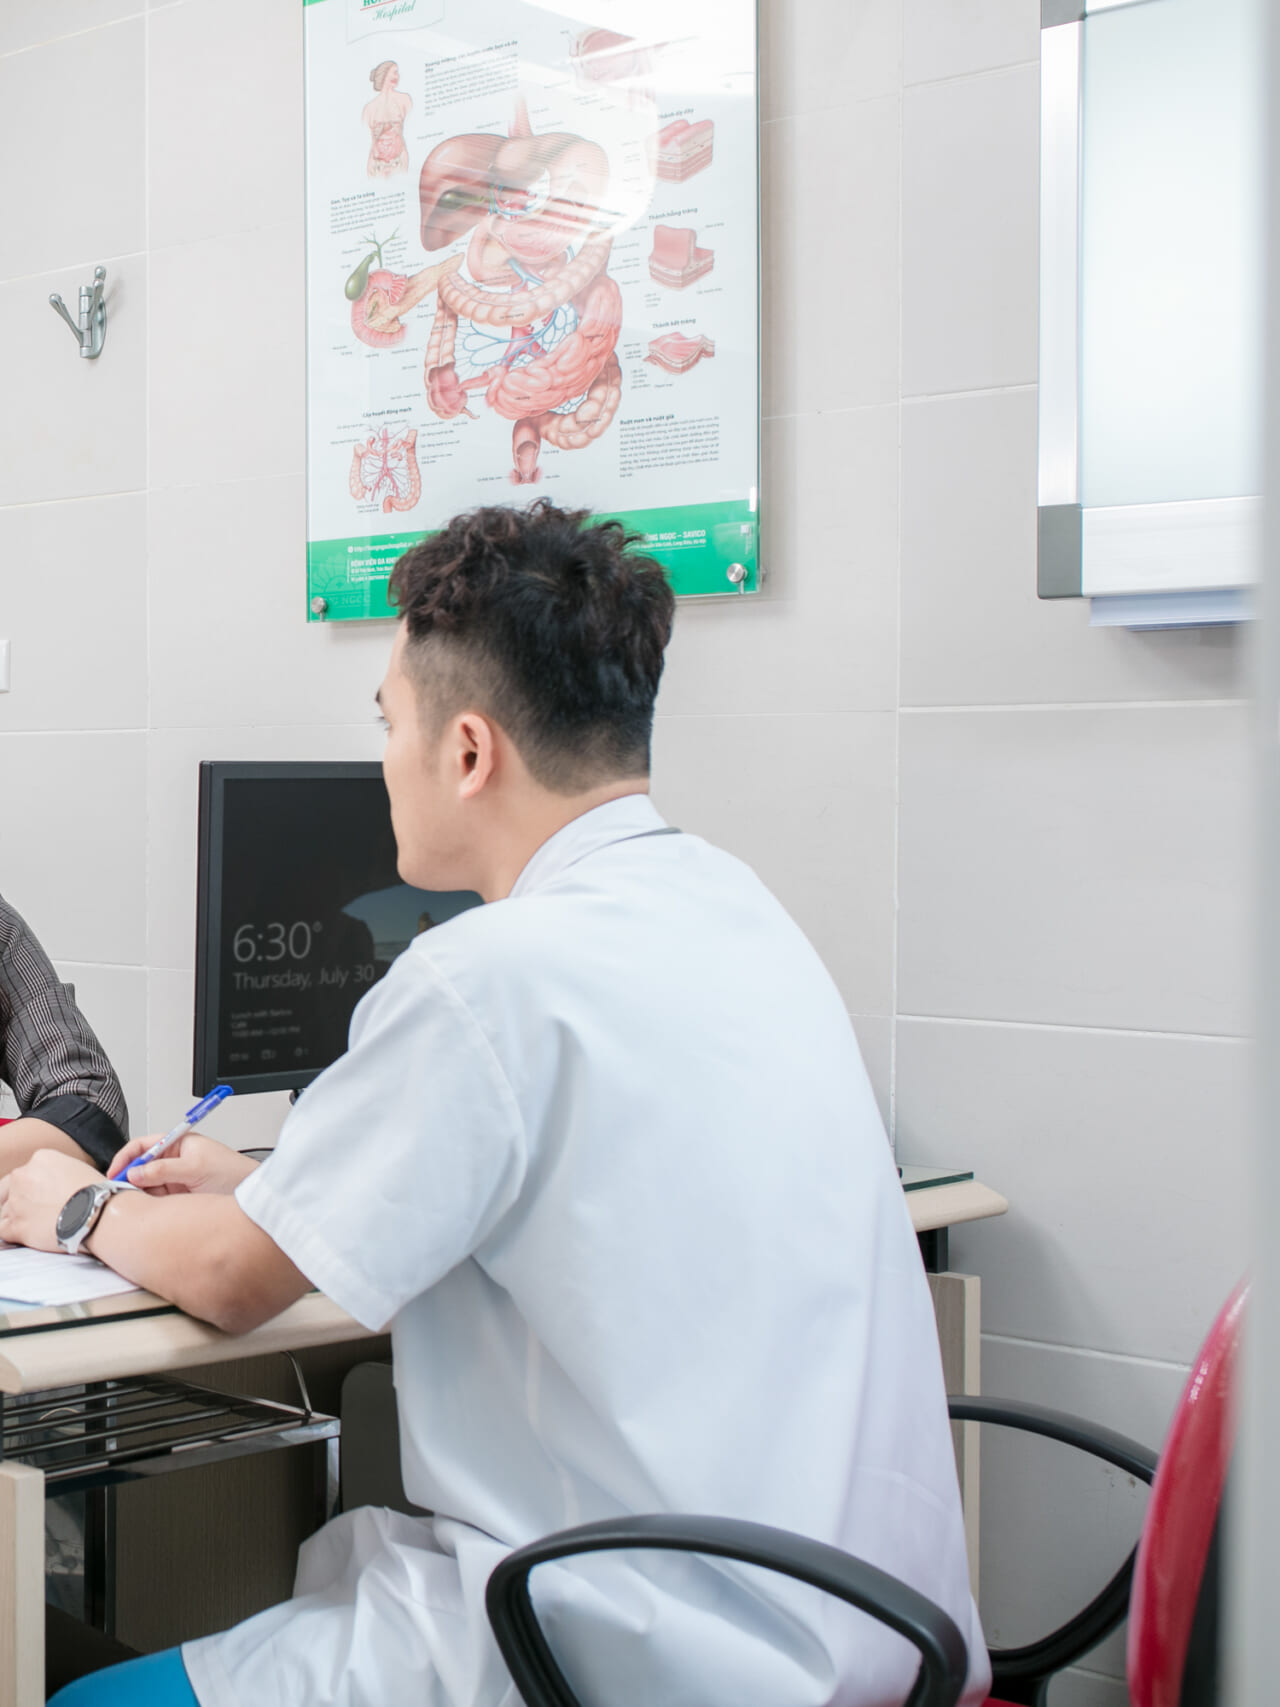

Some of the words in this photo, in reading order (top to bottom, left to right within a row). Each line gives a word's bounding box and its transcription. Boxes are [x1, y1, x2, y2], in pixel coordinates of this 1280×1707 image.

[232, 970, 312, 991] Thursday,
[318, 966, 349, 989] July
[352, 964, 376, 983] 30
